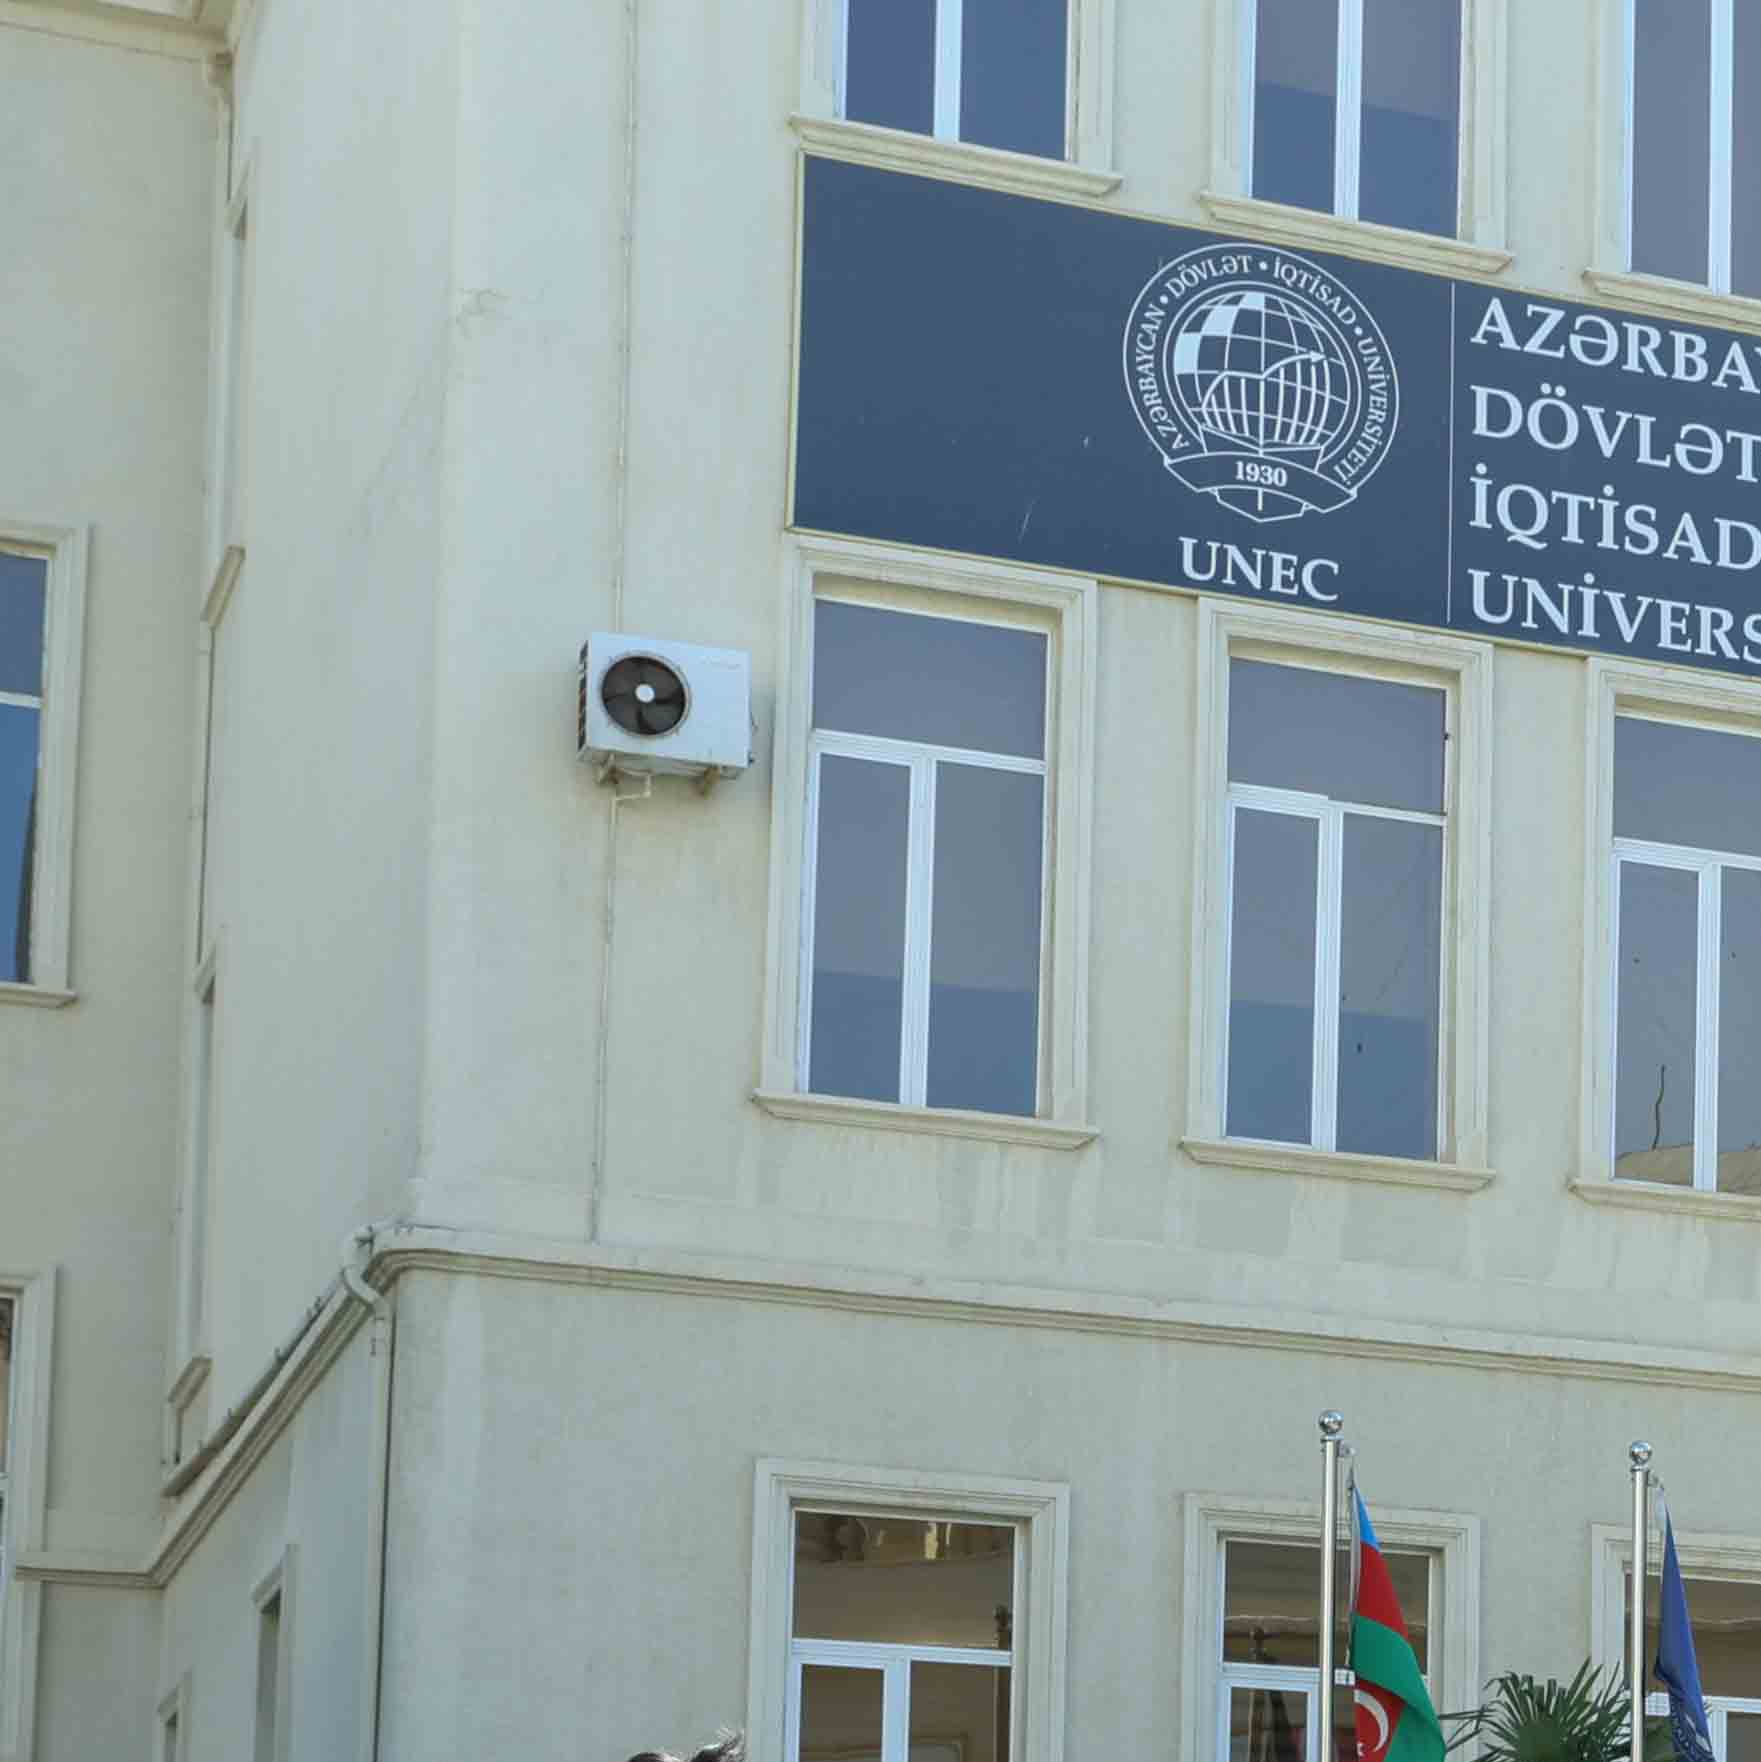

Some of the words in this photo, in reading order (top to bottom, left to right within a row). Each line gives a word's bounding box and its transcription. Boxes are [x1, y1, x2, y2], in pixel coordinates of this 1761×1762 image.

[1135, 303, 1191, 451] AZƏRBAYCAN
[1163, 254, 1253, 300] DÖVLƏT
[1273, 255, 1359, 326] İQTİSAD
[1234, 459, 1288, 487] 1930
[1177, 535, 1340, 601] UNEC
